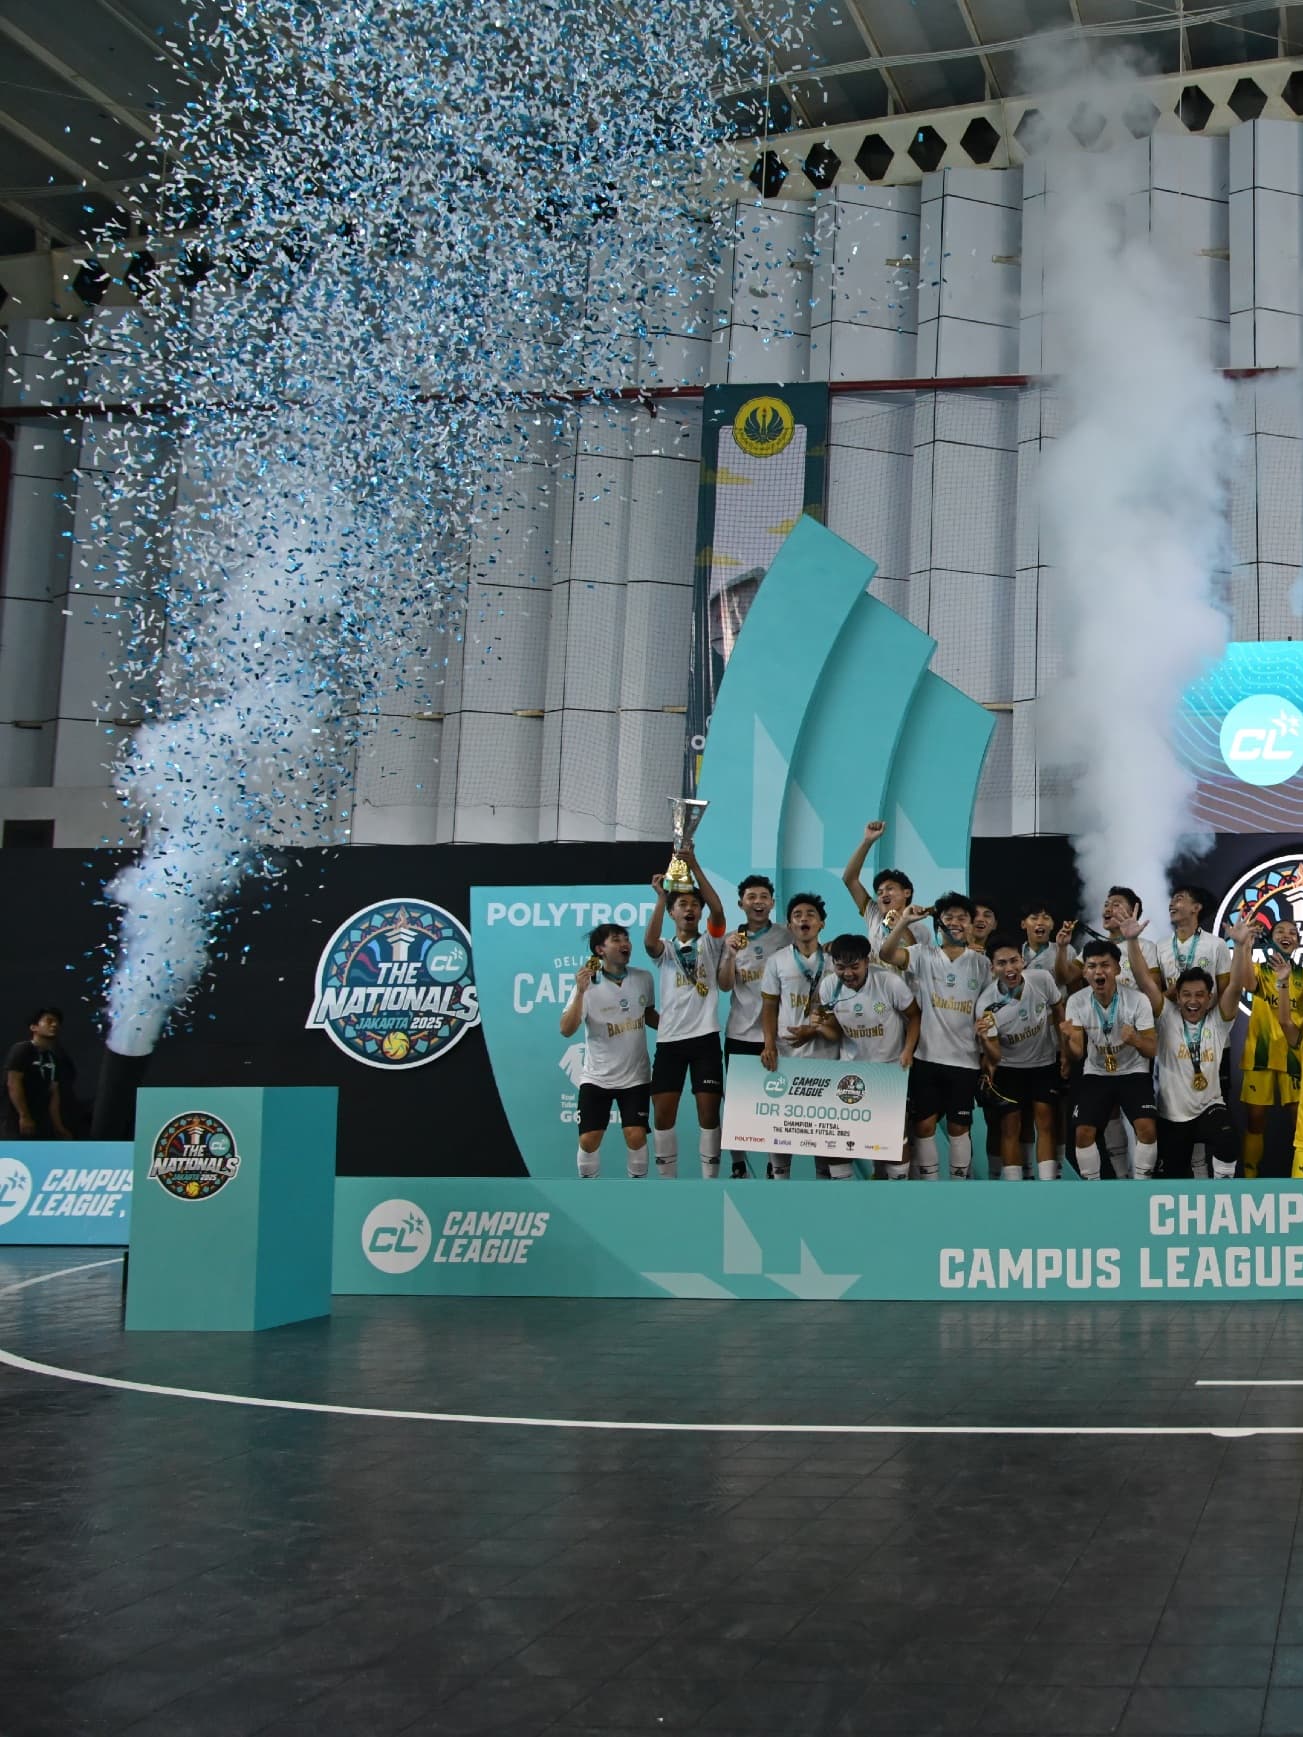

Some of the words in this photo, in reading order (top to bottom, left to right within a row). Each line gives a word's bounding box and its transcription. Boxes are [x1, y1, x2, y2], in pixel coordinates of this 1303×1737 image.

[1229, 728, 1294, 761] CL
[377, 962, 422, 985] THE
[430, 955, 462, 972] CL
[316, 986, 479, 1023] NATIONALS
[356, 1017, 409, 1030] JAKARTA
[410, 1016, 444, 1029] 2025
[788, 1086, 824, 1097] LEAGUE
[792, 1076, 831, 1088] CAMPUS
[756, 1102, 780, 1117] IDR
[784, 1104, 872, 1122] 30.000.000
[783, 1120, 813, 1128] CHAMPION
[818, 1122, 840, 1130] FUTSAL
[183, 1144, 207, 1157] THE
[150, 1157, 238, 1177] NATIONALS
[41, 1168, 134, 1191] CAMPUS
[28, 1193, 123, 1217] LEAGUE
[368, 1226, 419, 1253] CL
[442, 1210, 550, 1237] CAMPUS
[433, 1238, 534, 1264] LEAGUE
[939, 1247, 1121, 1289] CAMPUS
